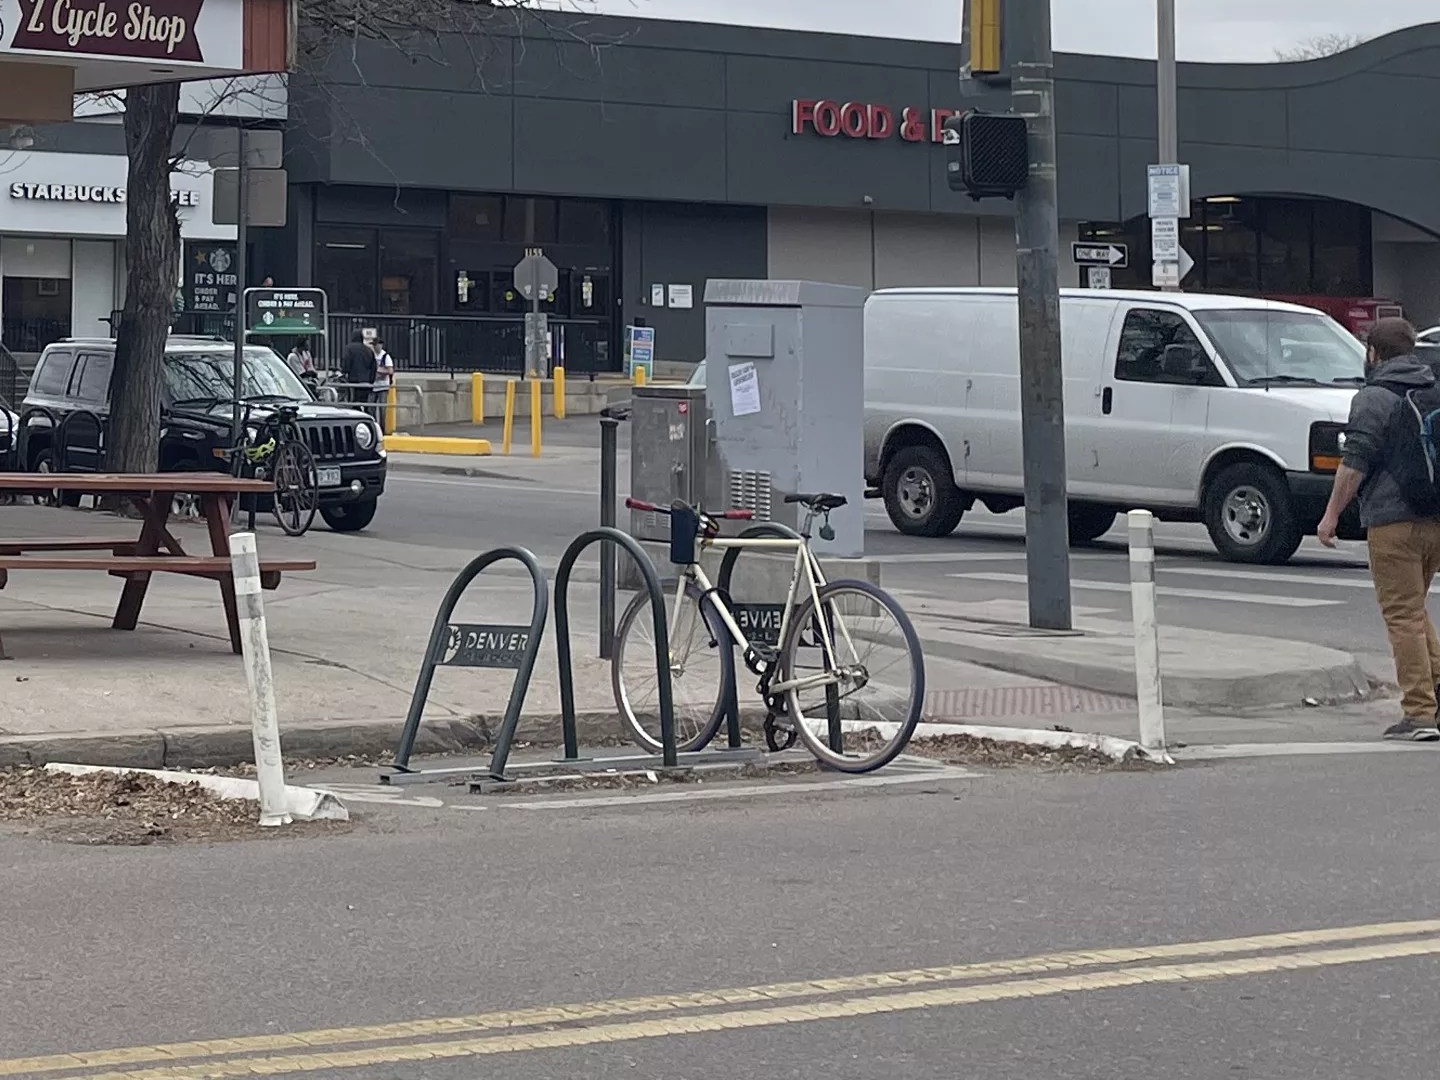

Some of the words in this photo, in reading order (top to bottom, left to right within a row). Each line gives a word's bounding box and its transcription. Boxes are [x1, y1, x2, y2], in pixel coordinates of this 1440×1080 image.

[123, 2, 186, 54] Shop
[792, 99, 894, 138] FOOD
[900, 106, 926, 142] &
[1148, 166, 1179, 176] NOTICE
[11, 182, 126, 203] STARBUCKS
[1077, 249, 1092, 258] ONE
[1096, 250, 1109, 258] WAY
[194, 273, 214, 285] IT'S
[216, 274, 237, 285] HER
[194, 287, 218, 295] ORDER
[465, 631, 529, 651] DENVER
